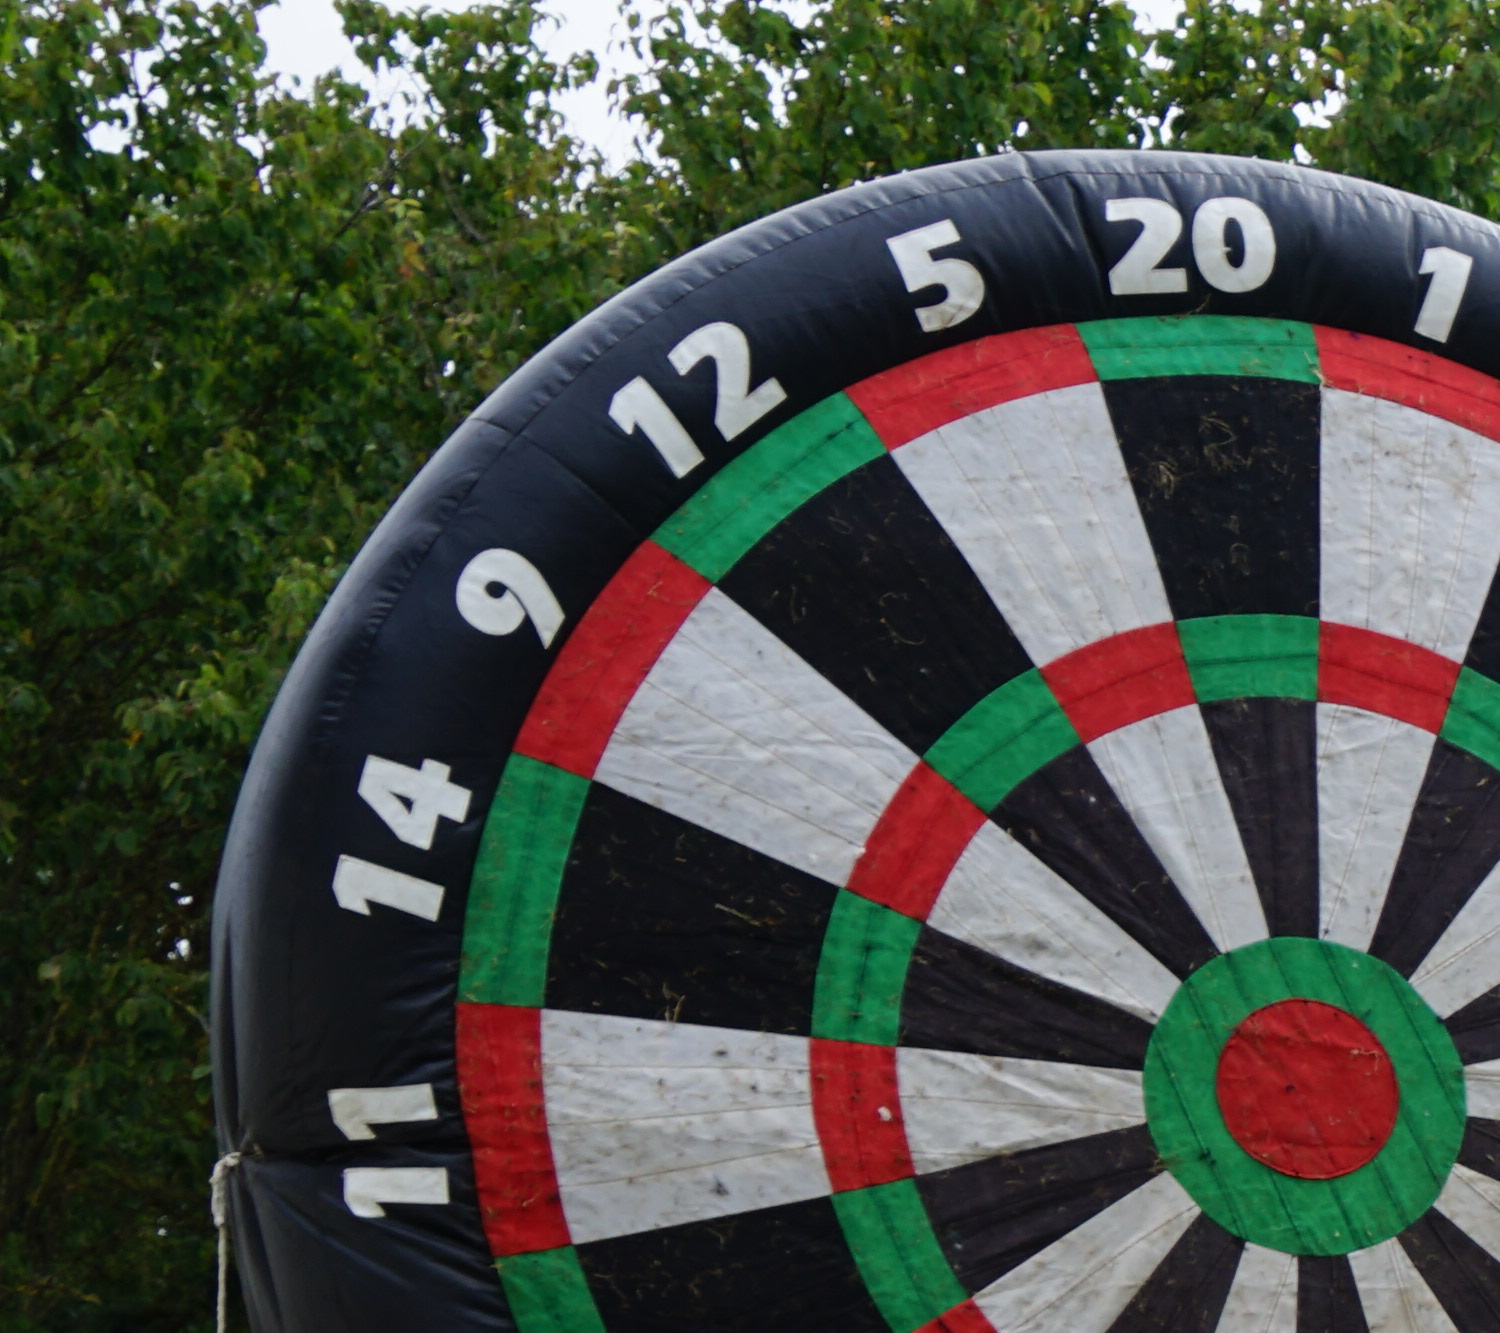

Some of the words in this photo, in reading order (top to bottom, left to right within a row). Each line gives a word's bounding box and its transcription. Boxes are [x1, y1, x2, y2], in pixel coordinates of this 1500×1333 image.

[886, 219, 984, 331] 5
[1105, 197, 1276, 294] 20
[1415, 246, 1473, 342] 1
[609, 322, 786, 478] 12
[456, 549, 564, 647] 9
[333, 756, 471, 921] 14
[333, 1084, 449, 1217] 11
